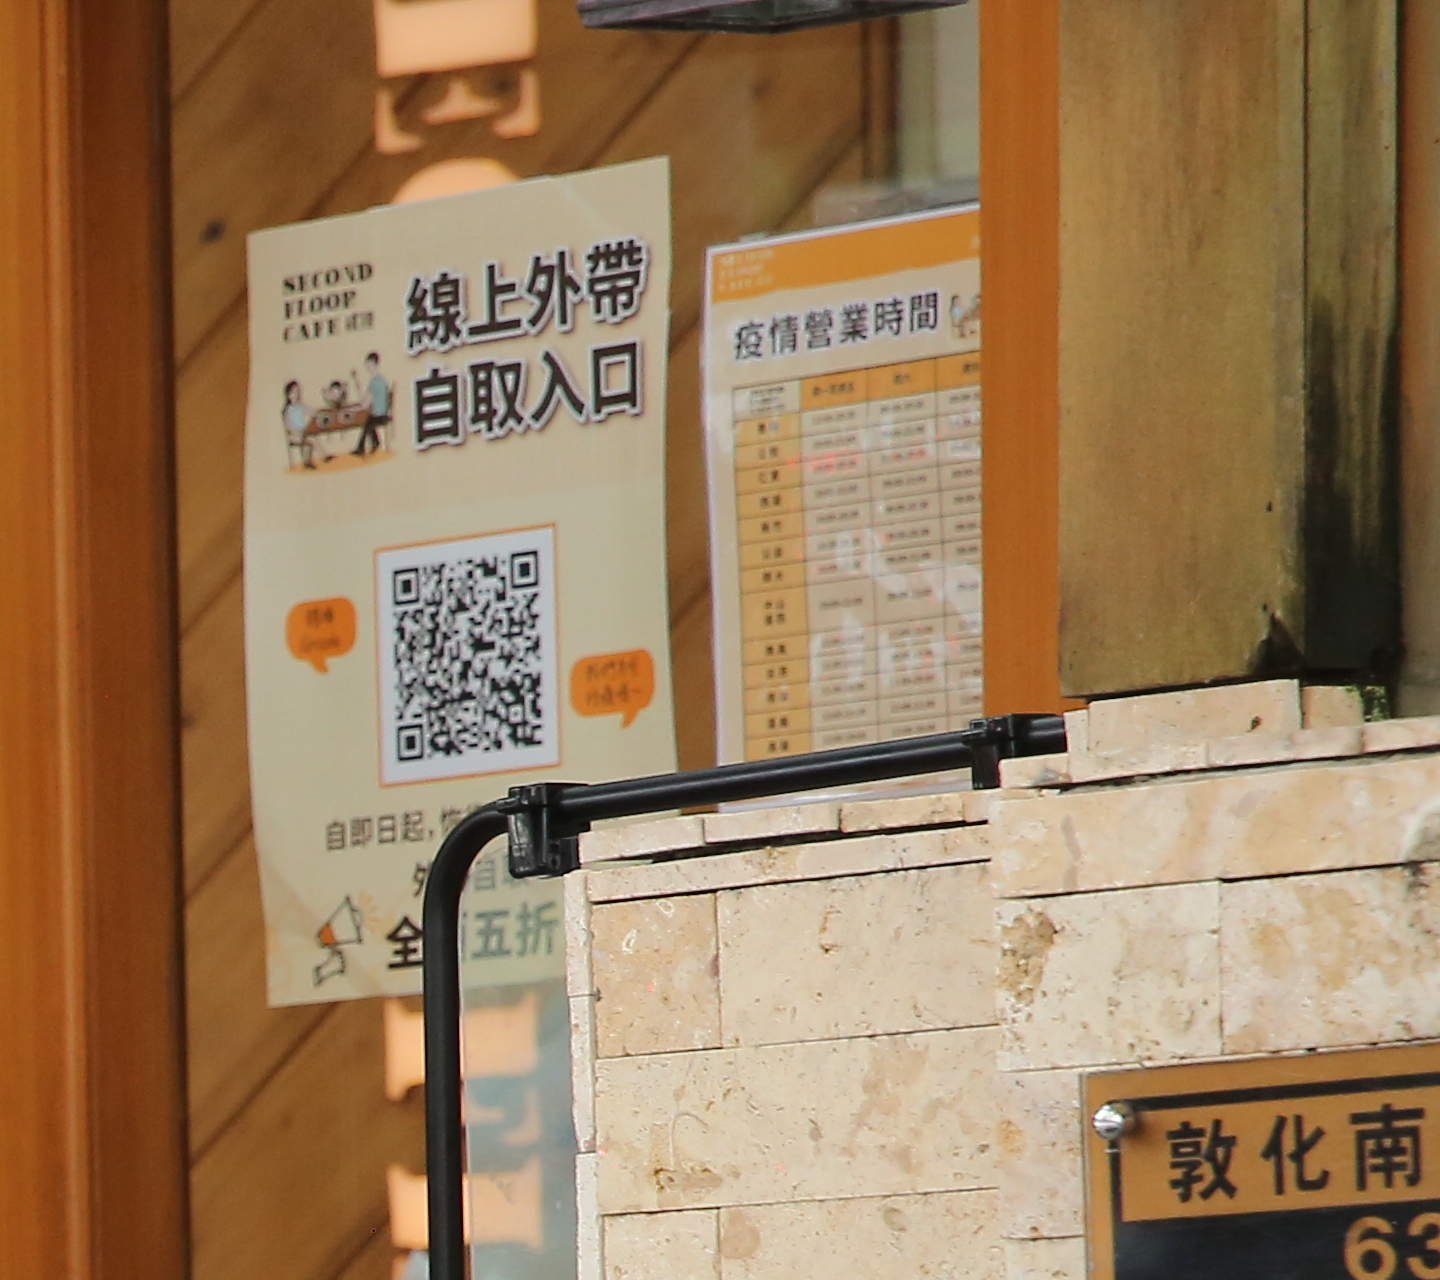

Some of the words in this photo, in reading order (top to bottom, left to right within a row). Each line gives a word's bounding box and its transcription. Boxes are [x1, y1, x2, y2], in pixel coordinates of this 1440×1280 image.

[406, 239, 644, 349] 線上外帶
[735, 292, 938, 360] 疫情營業時間
[414, 343, 639, 444] 自取入口
[387, 900, 559, 969] 全五折
[1166, 1104, 1425, 1202] 敦化南
